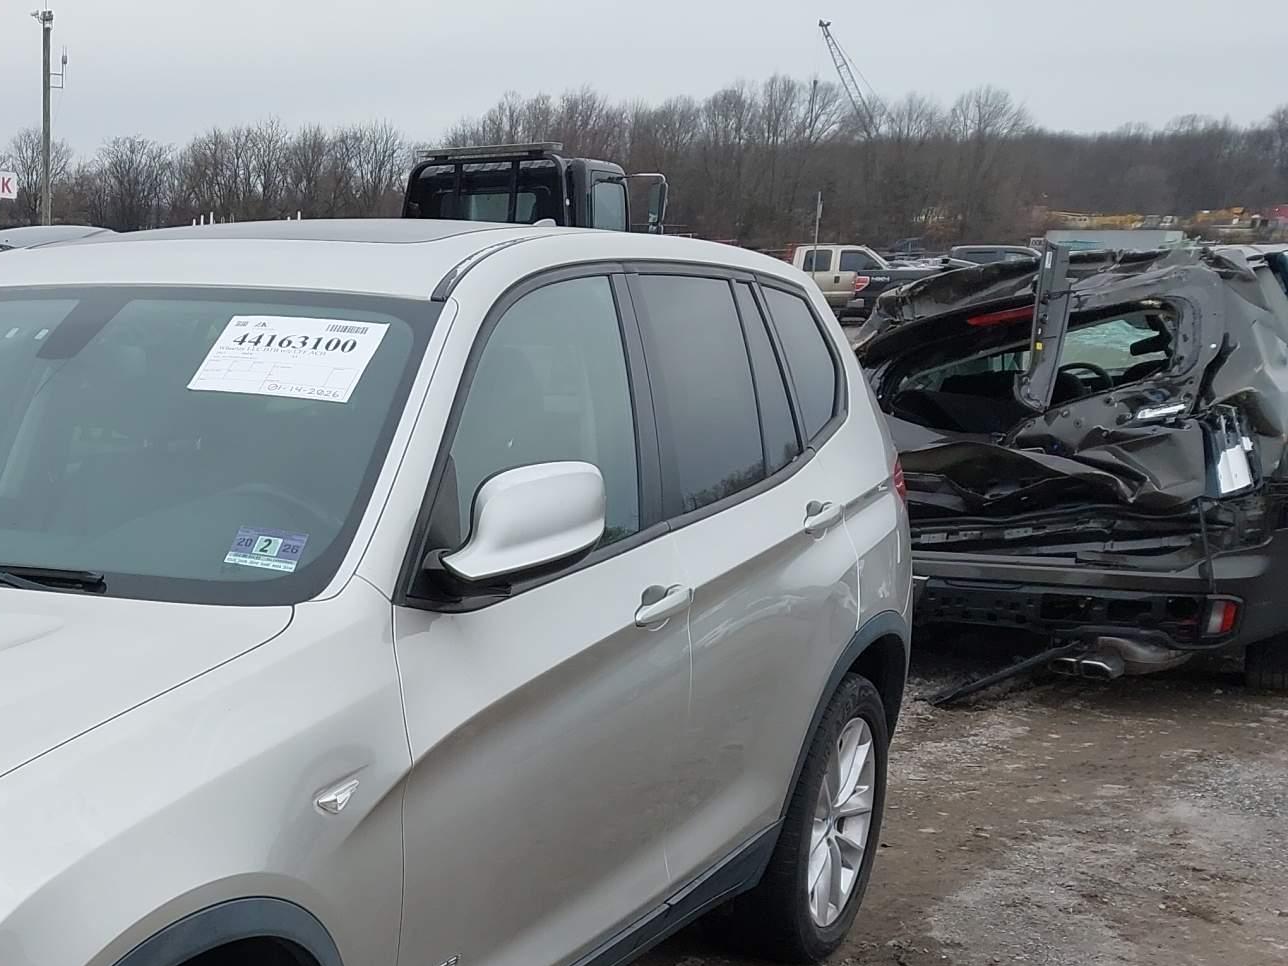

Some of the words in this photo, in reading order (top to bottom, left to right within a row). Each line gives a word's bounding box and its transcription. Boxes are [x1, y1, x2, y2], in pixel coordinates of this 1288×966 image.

[2, 177, 12, 194] K
[233, 332, 357, 353] 44163100
[237, 537, 253, 548] 20
[259, 539, 272, 553] 2
[282, 543, 300, 554] 26
